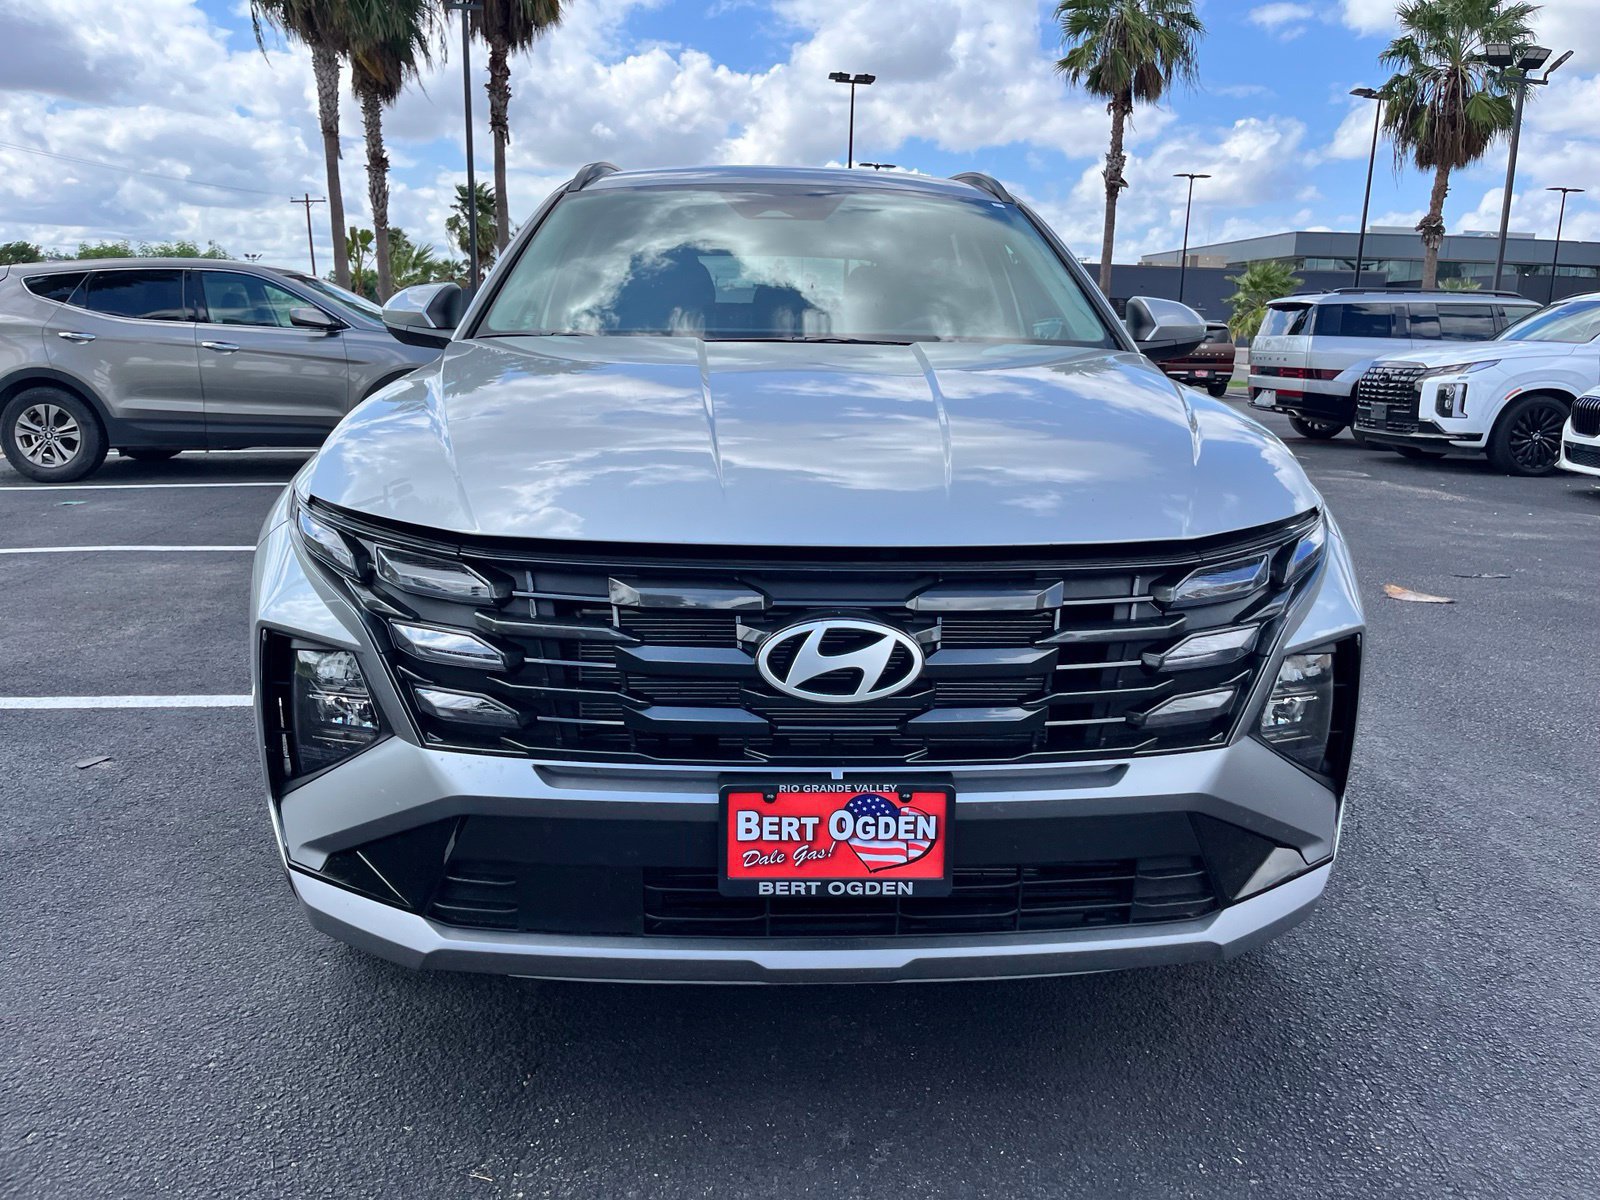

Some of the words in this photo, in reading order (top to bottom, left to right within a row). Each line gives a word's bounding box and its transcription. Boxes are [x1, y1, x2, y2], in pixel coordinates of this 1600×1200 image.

[779, 784, 799, 793] RIO
[803, 784, 851, 793] GRANDE
[854, 784, 897, 793] VALLEY
[737, 810, 819, 841] BERT
[828, 809, 937, 841] OGDEN
[742, 850, 785, 867] Dale
[793, 841, 836, 867] Gas!
[758, 882, 821, 895] BERT
[827, 881, 913, 895] OGDEN
